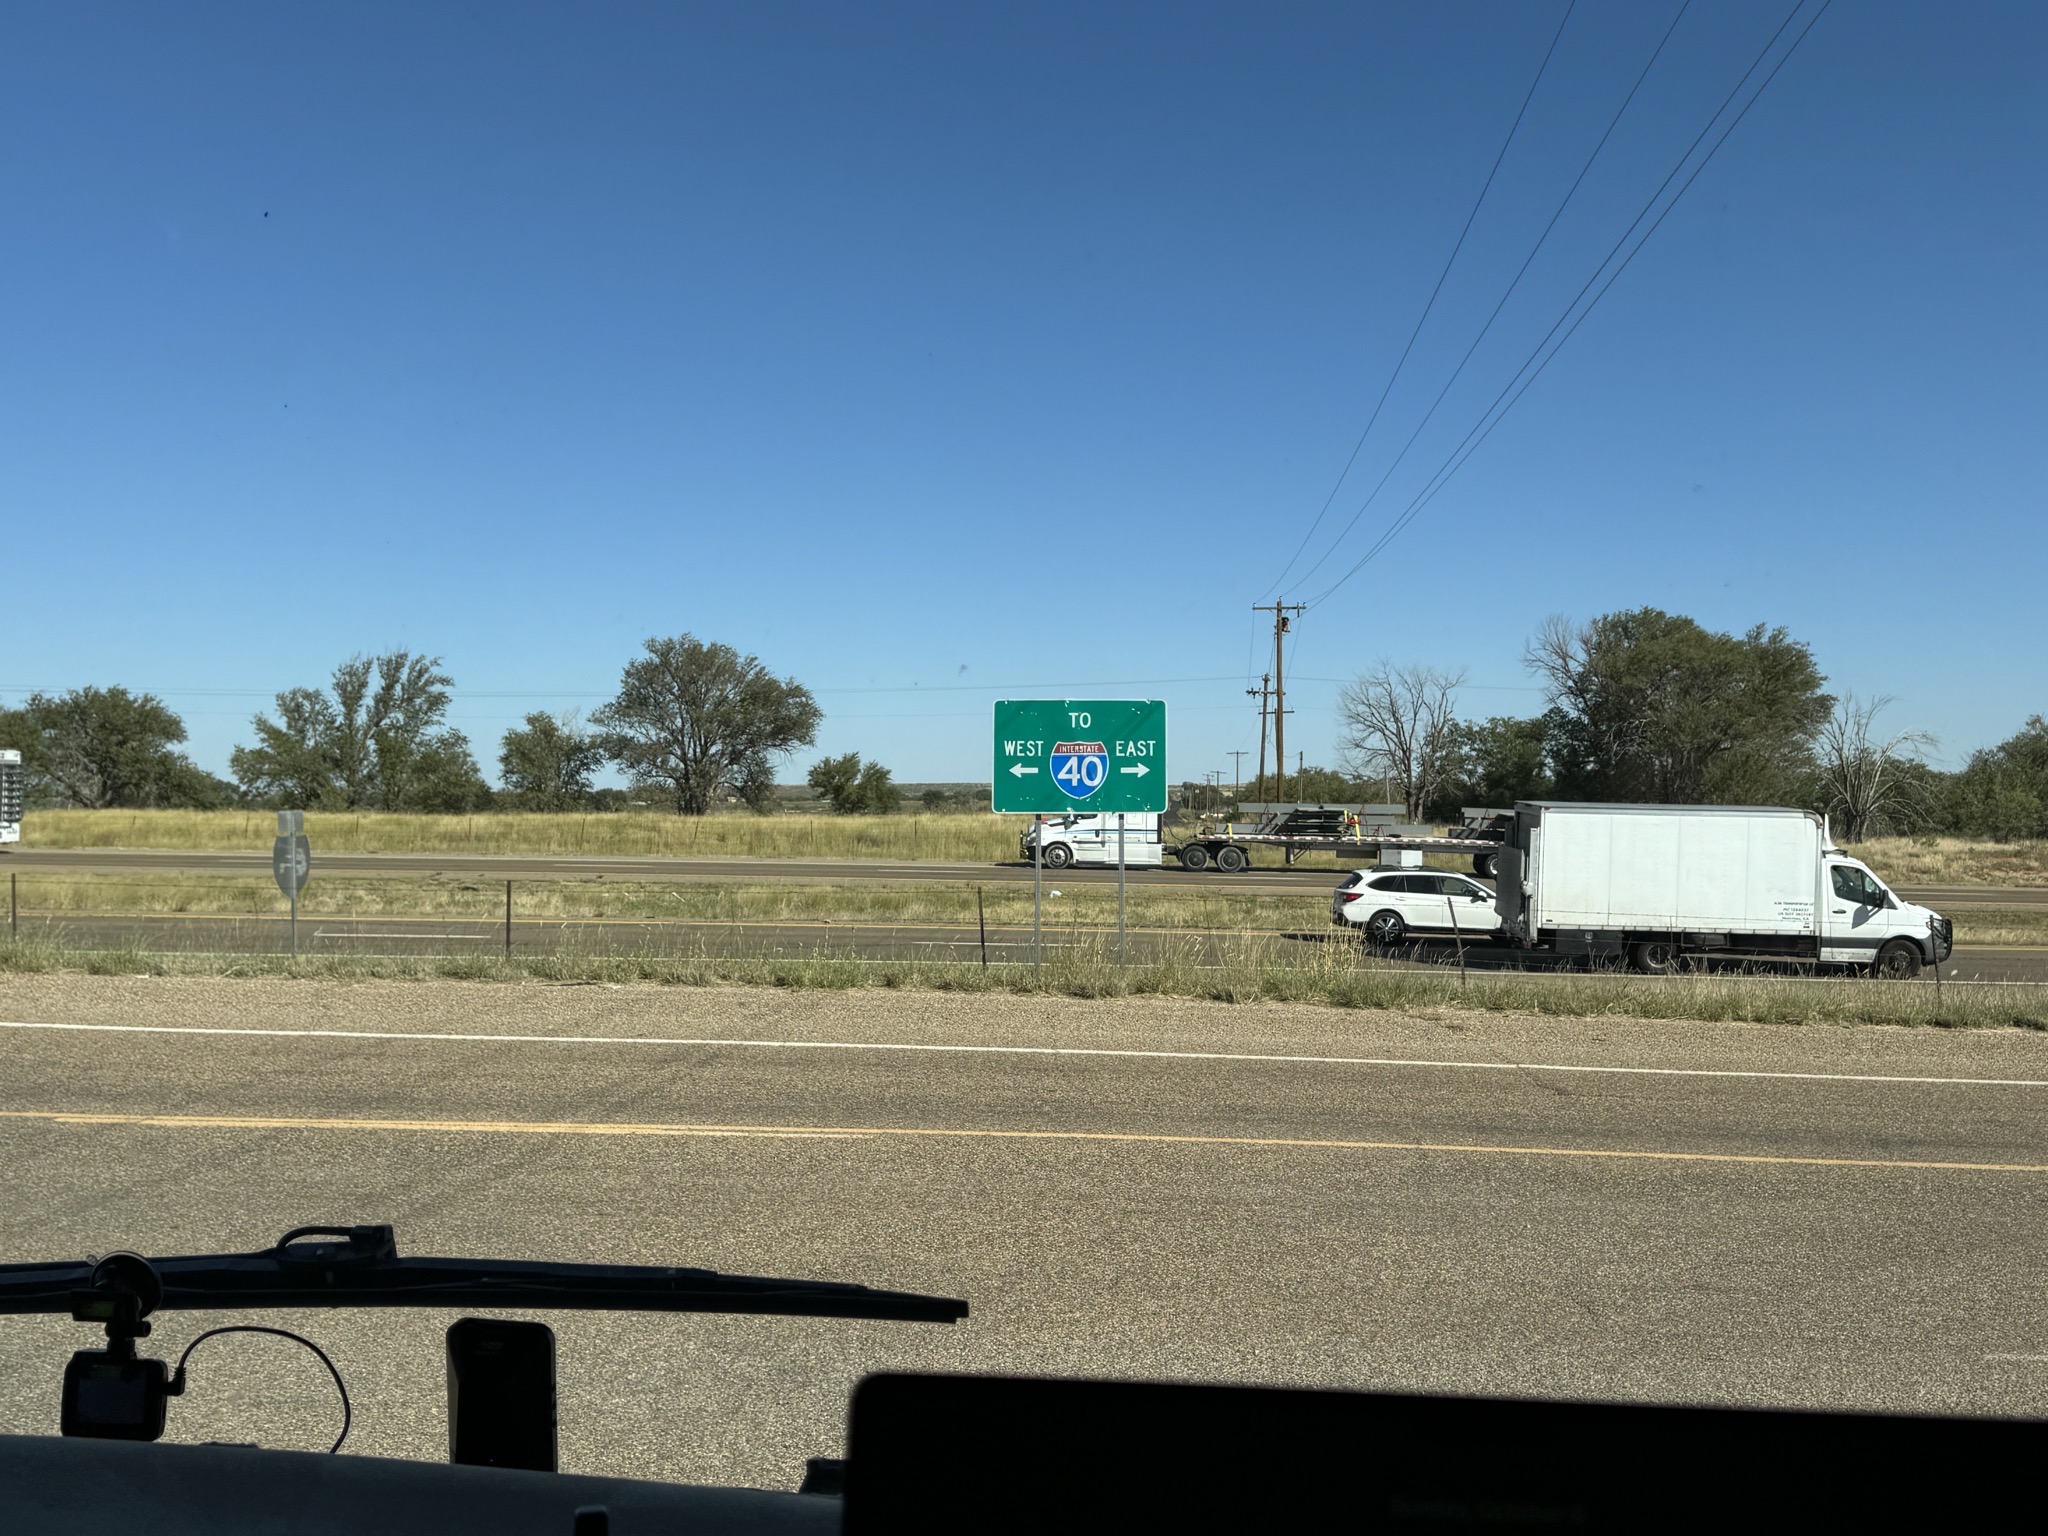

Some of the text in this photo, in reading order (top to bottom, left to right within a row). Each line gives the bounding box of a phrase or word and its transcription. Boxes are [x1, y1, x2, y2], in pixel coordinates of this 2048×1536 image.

[1069, 712, 1091, 728] TO
[1004, 741, 1044, 756] WEST
[1059, 745, 1099, 753] INTERSTATE
[1116, 741, 1156, 756] EAST
[1057, 756, 1103, 786] 40
